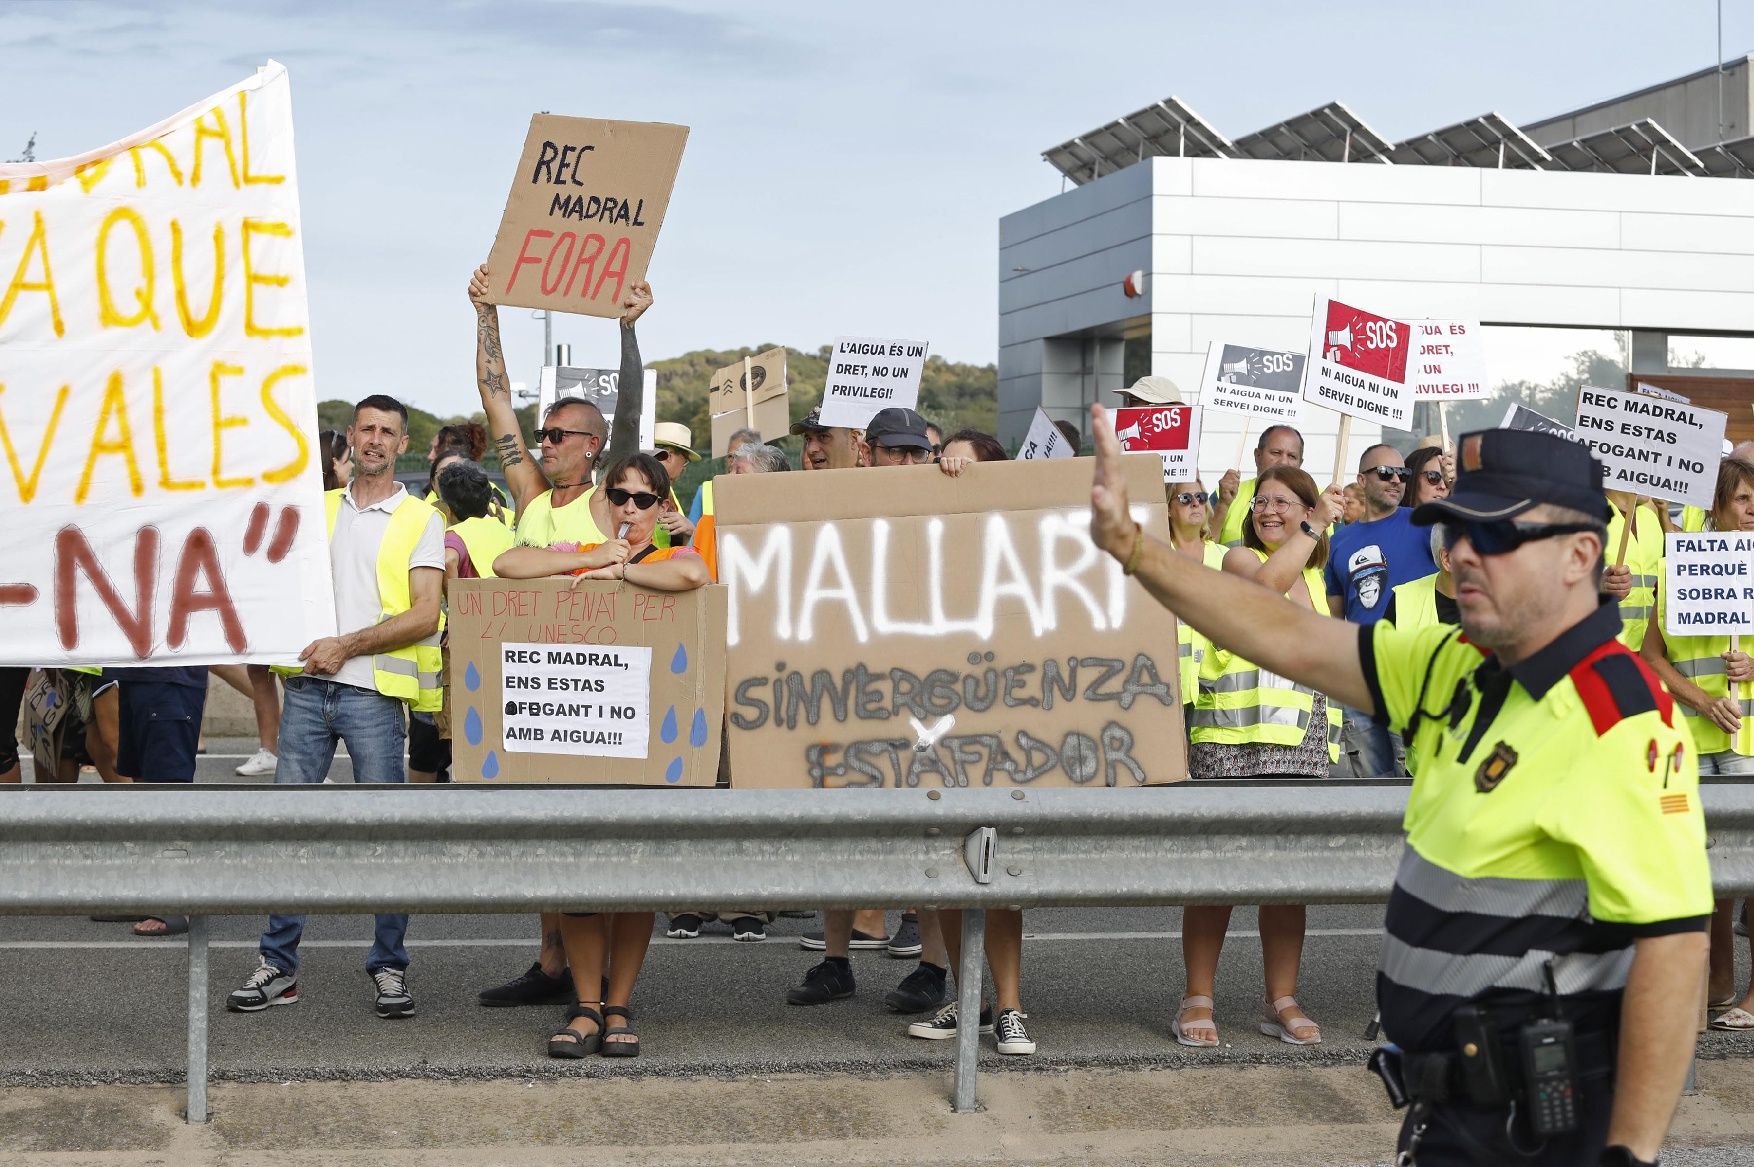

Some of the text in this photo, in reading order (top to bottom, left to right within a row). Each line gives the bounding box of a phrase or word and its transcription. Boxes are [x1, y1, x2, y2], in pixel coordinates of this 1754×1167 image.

[532, 140, 595, 187] REC
[549, 193, 645, 227] MADRAL
[96, 206, 304, 338] QUE
[505, 229, 631, 304] FORA
[1366, 320, 1398, 349] SOS
[840, 342, 923, 357] L'AIGUA ÉS UN
[836, 364, 909, 378] DRET, NO UN
[1263, 354, 1294, 373] SOS
[1424, 364, 1442, 374] UN
[832, 385, 893, 399] PRIVILEGI!
[1321, 366, 1398, 399] NI AIGUA NI UN
[1230, 389, 1261, 399] AIGUA
[1319, 386, 1354, 406] SERVEI
[1357, 398, 1389, 416] DIGNE
[1213, 398, 1250, 410] SERVEI
[1253, 405, 1284, 415] DIGNE
[1582, 392, 1618, 409] REC
[1624, 400, 1703, 430] MADRAL,
[1152, 408, 1181, 432] SOS
[1578, 415, 1677, 444] ENS ESTAS
[0, 360, 310, 504] VALES
[1170, 455, 1183, 463] UN
[1667, 456, 1672, 467] I
[1678, 459, 1704, 474] NO
[1616, 469, 1689, 494] AIGUA!!!
[1676, 539, 1754, 552] FALTA AI
[1676, 560, 1748, 577] PERQUÈ
[1677, 588, 1738, 600] SOBRA
[457, 591, 678, 622] UN DRET PENAT PER
[1678, 612, 1750, 624] MADRAL
[505, 650, 629, 670] REC MADRAL,
[505, 676, 605, 692] ENS ESTAS
[598, 705, 603, 718] I
[610, 706, 636, 719] NO
[505, 727, 622, 745] AMB AIGUA!!!
[806, 720, 1146, 788] ESTAFADOR
